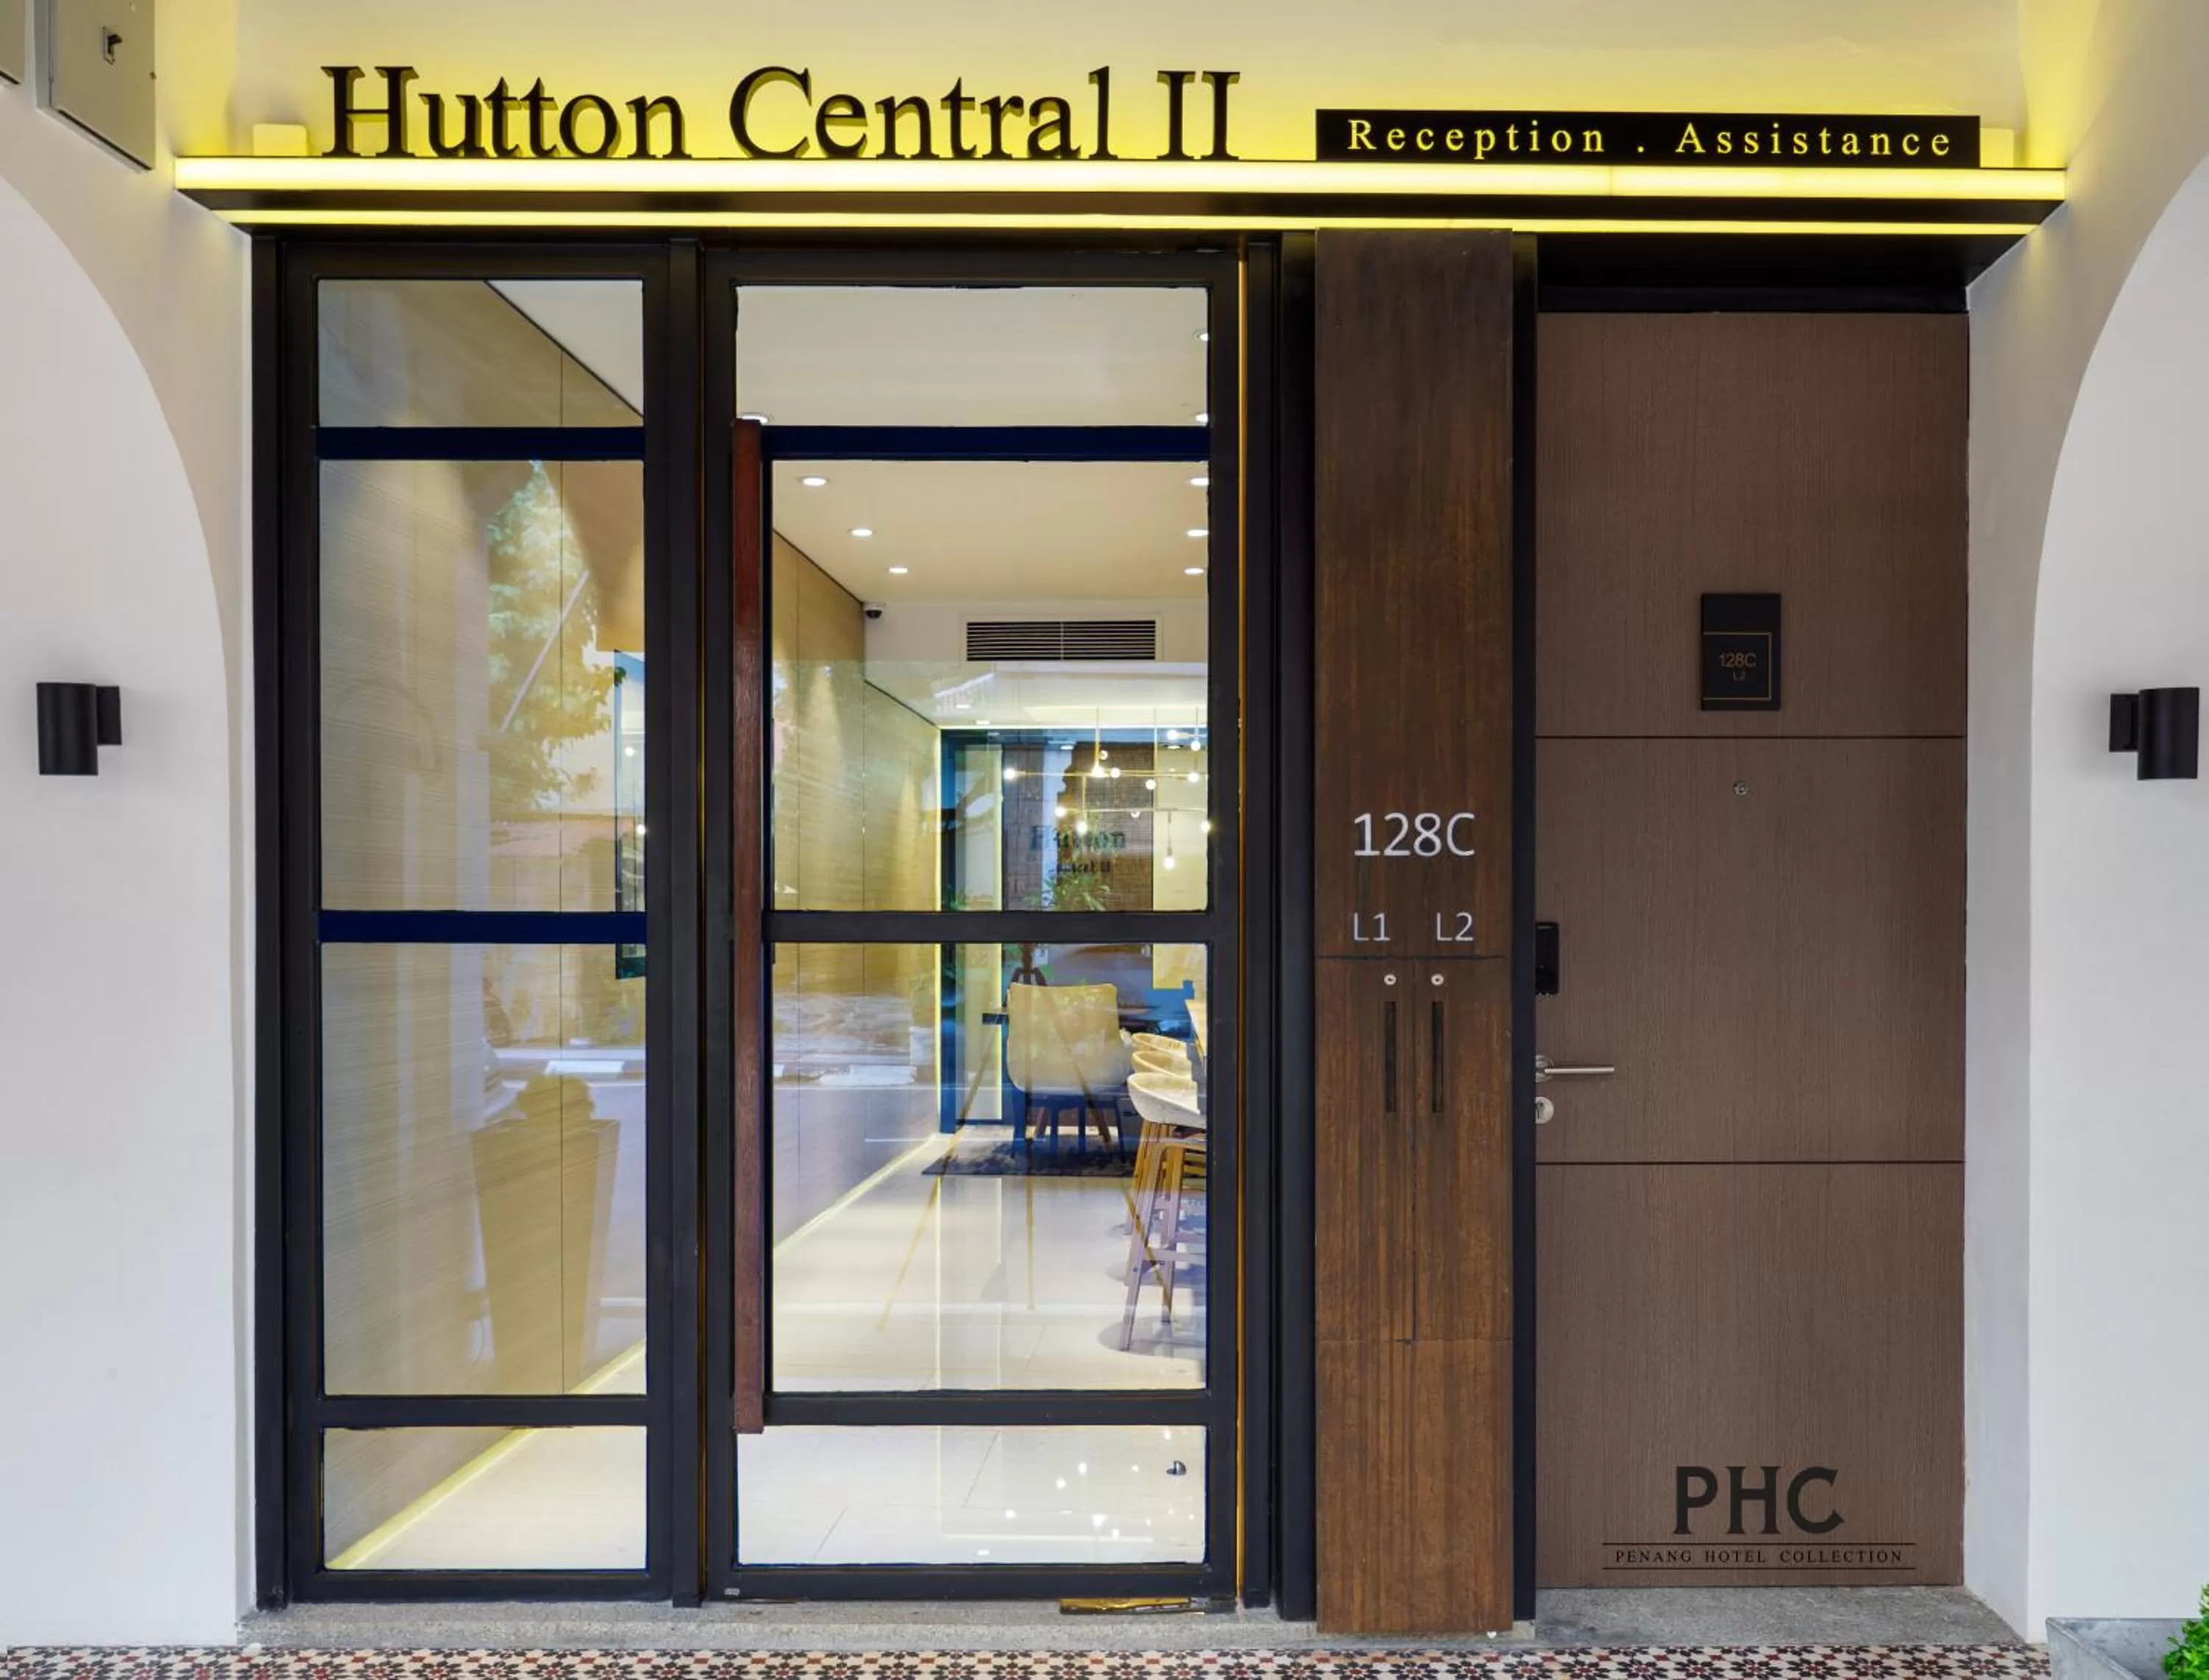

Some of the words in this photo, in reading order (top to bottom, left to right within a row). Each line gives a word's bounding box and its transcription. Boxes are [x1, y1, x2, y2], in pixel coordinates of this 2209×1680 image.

[321, 66, 692, 158] Hutton
[728, 65, 1118, 160] Central
[1157, 70, 1241, 160] II
[1347, 119, 1604, 160] Reception
[1675, 122, 1951, 155] Assistance
[1717, 652, 1756, 668] 128C
[1353, 812, 1476, 857] 128C
[1353, 912, 1391, 942] L1
[1436, 912, 1474, 942] L2
[1672, 1465, 1845, 1535] PHC
[1616, 1550, 1692, 1564] PENANG
[1705, 1550, 1767, 1564] HOTEL
[1780, 1550, 1903, 1564] COLLECTION
